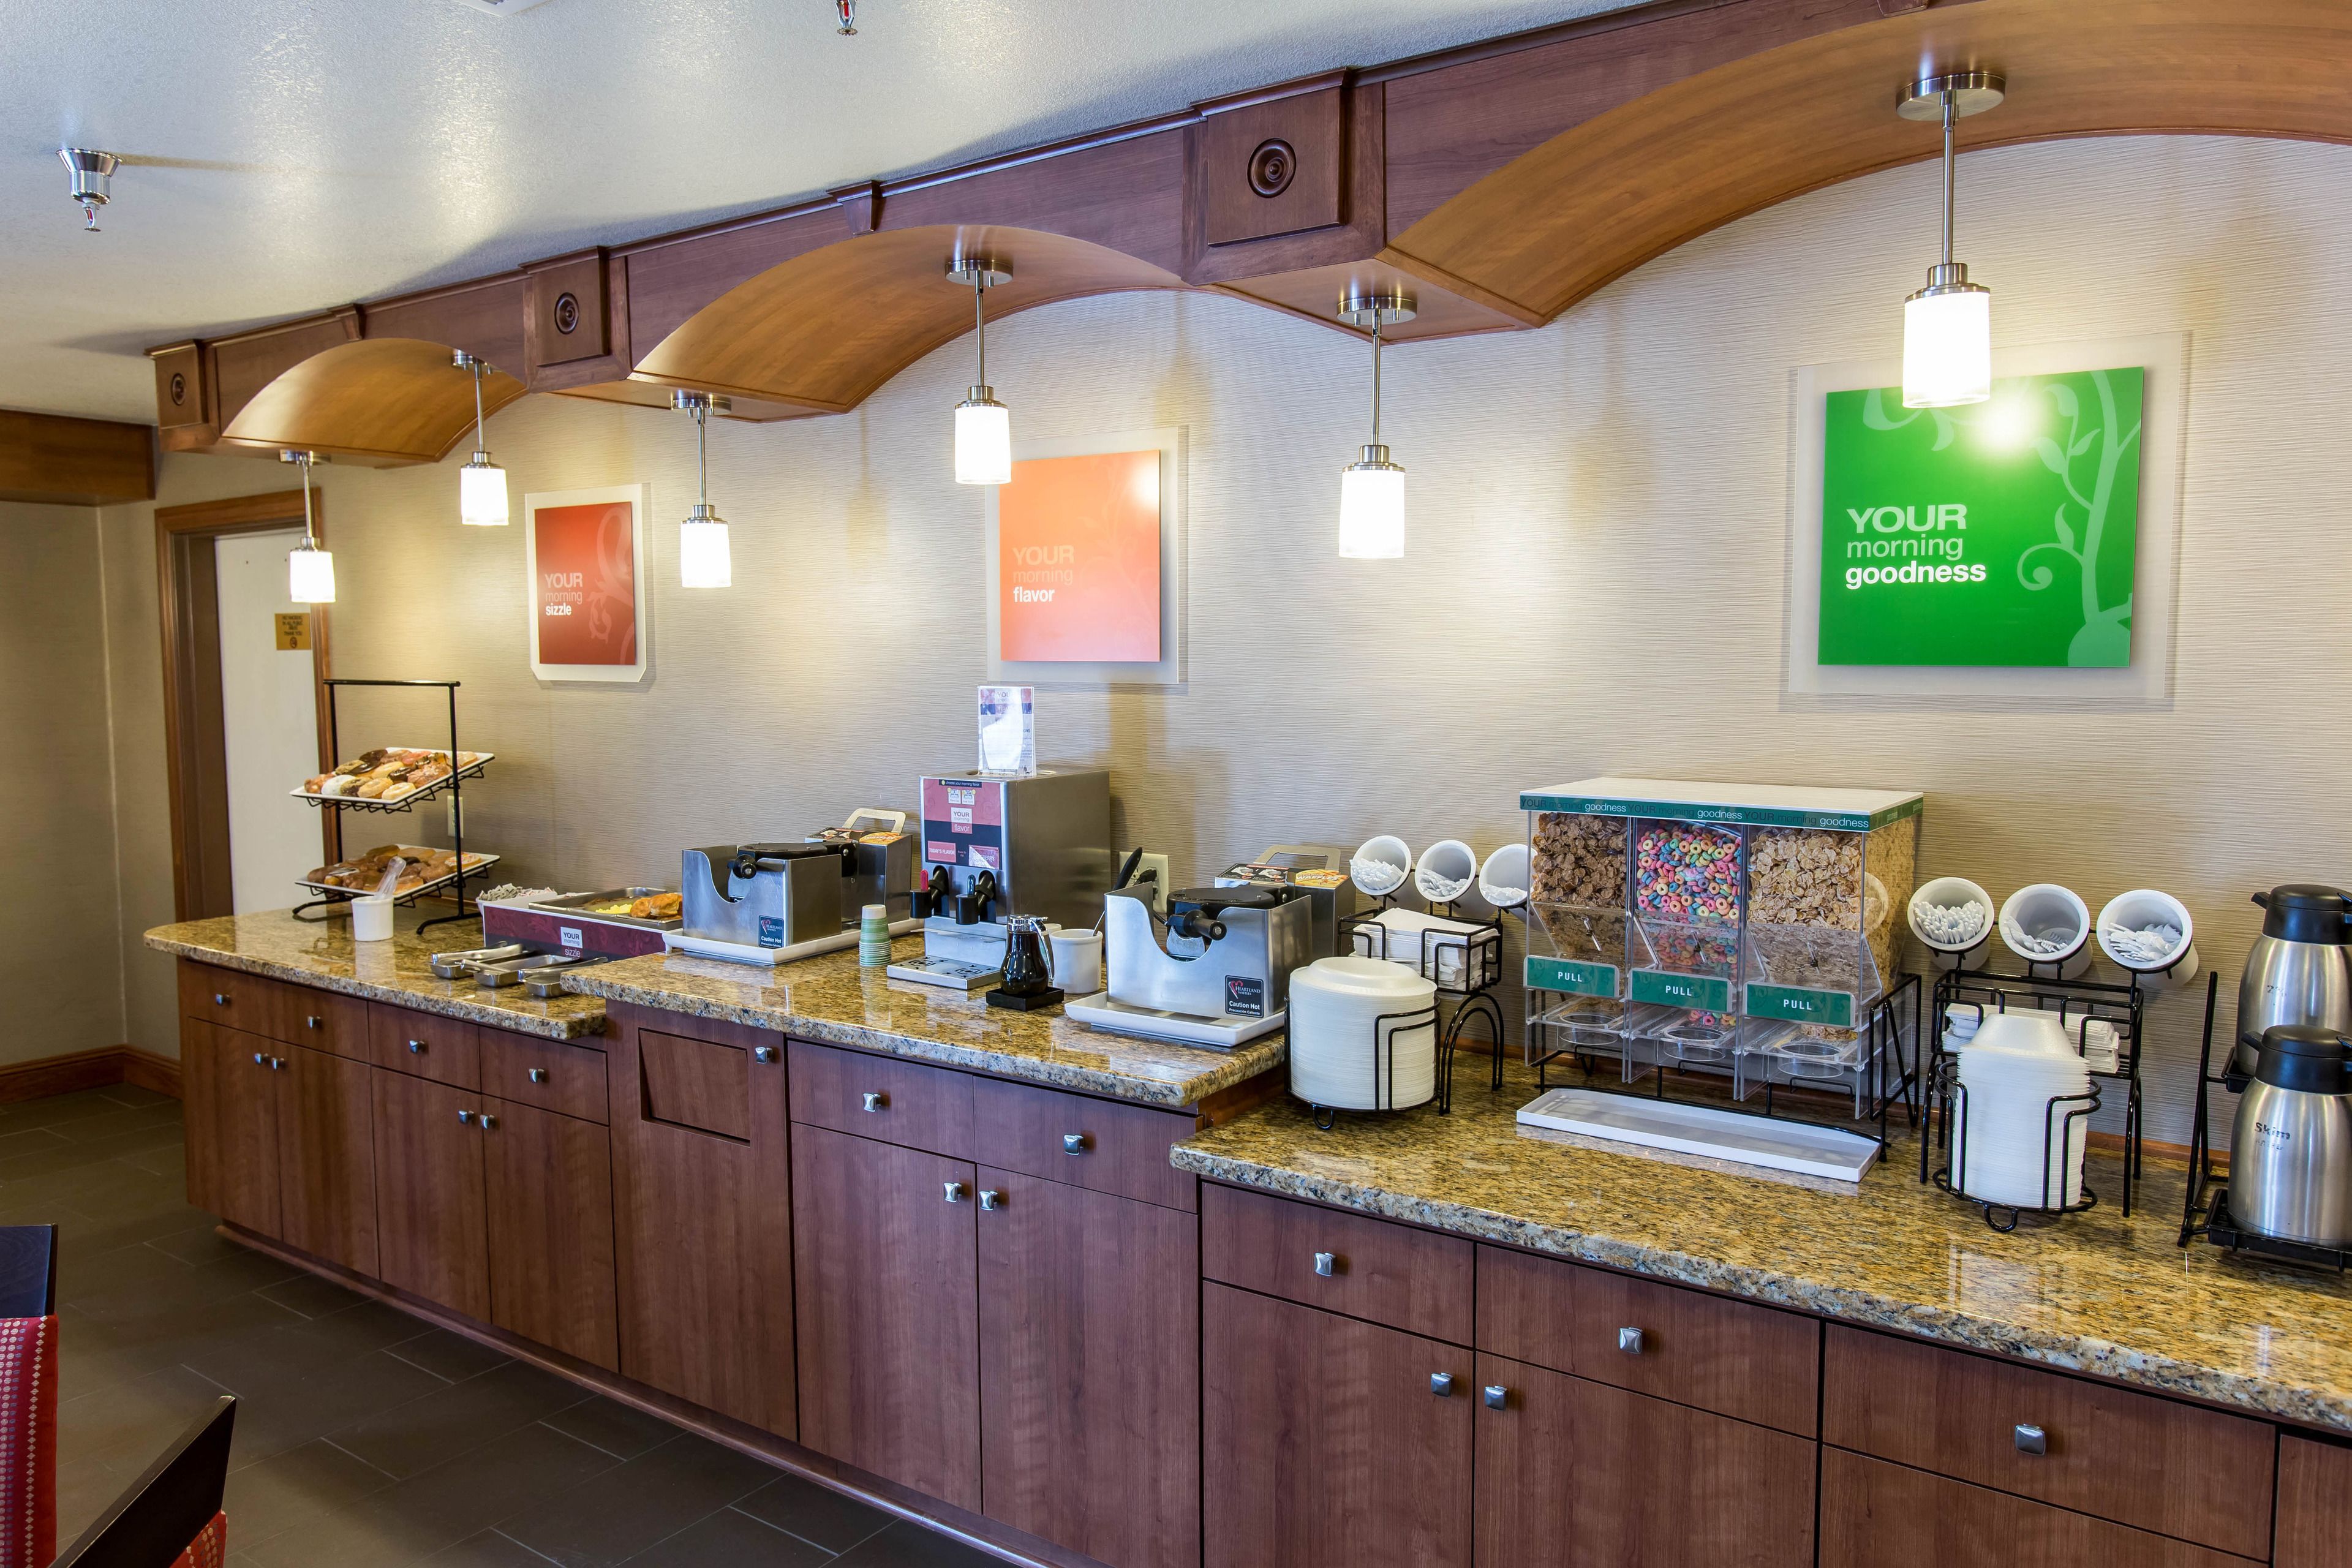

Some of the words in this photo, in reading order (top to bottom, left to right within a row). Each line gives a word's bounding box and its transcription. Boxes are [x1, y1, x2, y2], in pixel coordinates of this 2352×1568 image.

[1846, 503, 1967, 533] YOUR
[1847, 533, 1962, 560] morning
[1012, 545, 1074, 566] YOUR
[545, 571, 583, 589] YOUR
[1013, 567, 1072, 586] morning
[1845, 560, 1986, 590] goodness
[545, 589, 582, 605] morning
[1013, 586, 1055, 603] flavor
[545, 602, 572, 616] sizzle
[1521, 799, 1547, 807] YOUR
[1550, 801, 1582, 810] morning
[1585, 803, 1626, 812] goodness
[1628, 804, 1656, 813] YOUR
[1659, 807, 1694, 817] morning
[1697, 810, 1742, 820] goodness
[1744, 811, 1774, 820] YOUR
[1778, 814, 1816, 826] morning
[1820, 818, 1869, 827] goodness
[565, 947, 581, 957] sizzle
[1558, 971, 1582, 982] PULL
[1665, 985, 1692, 996] PULL
[1784, 999, 1812, 1010] PULL
